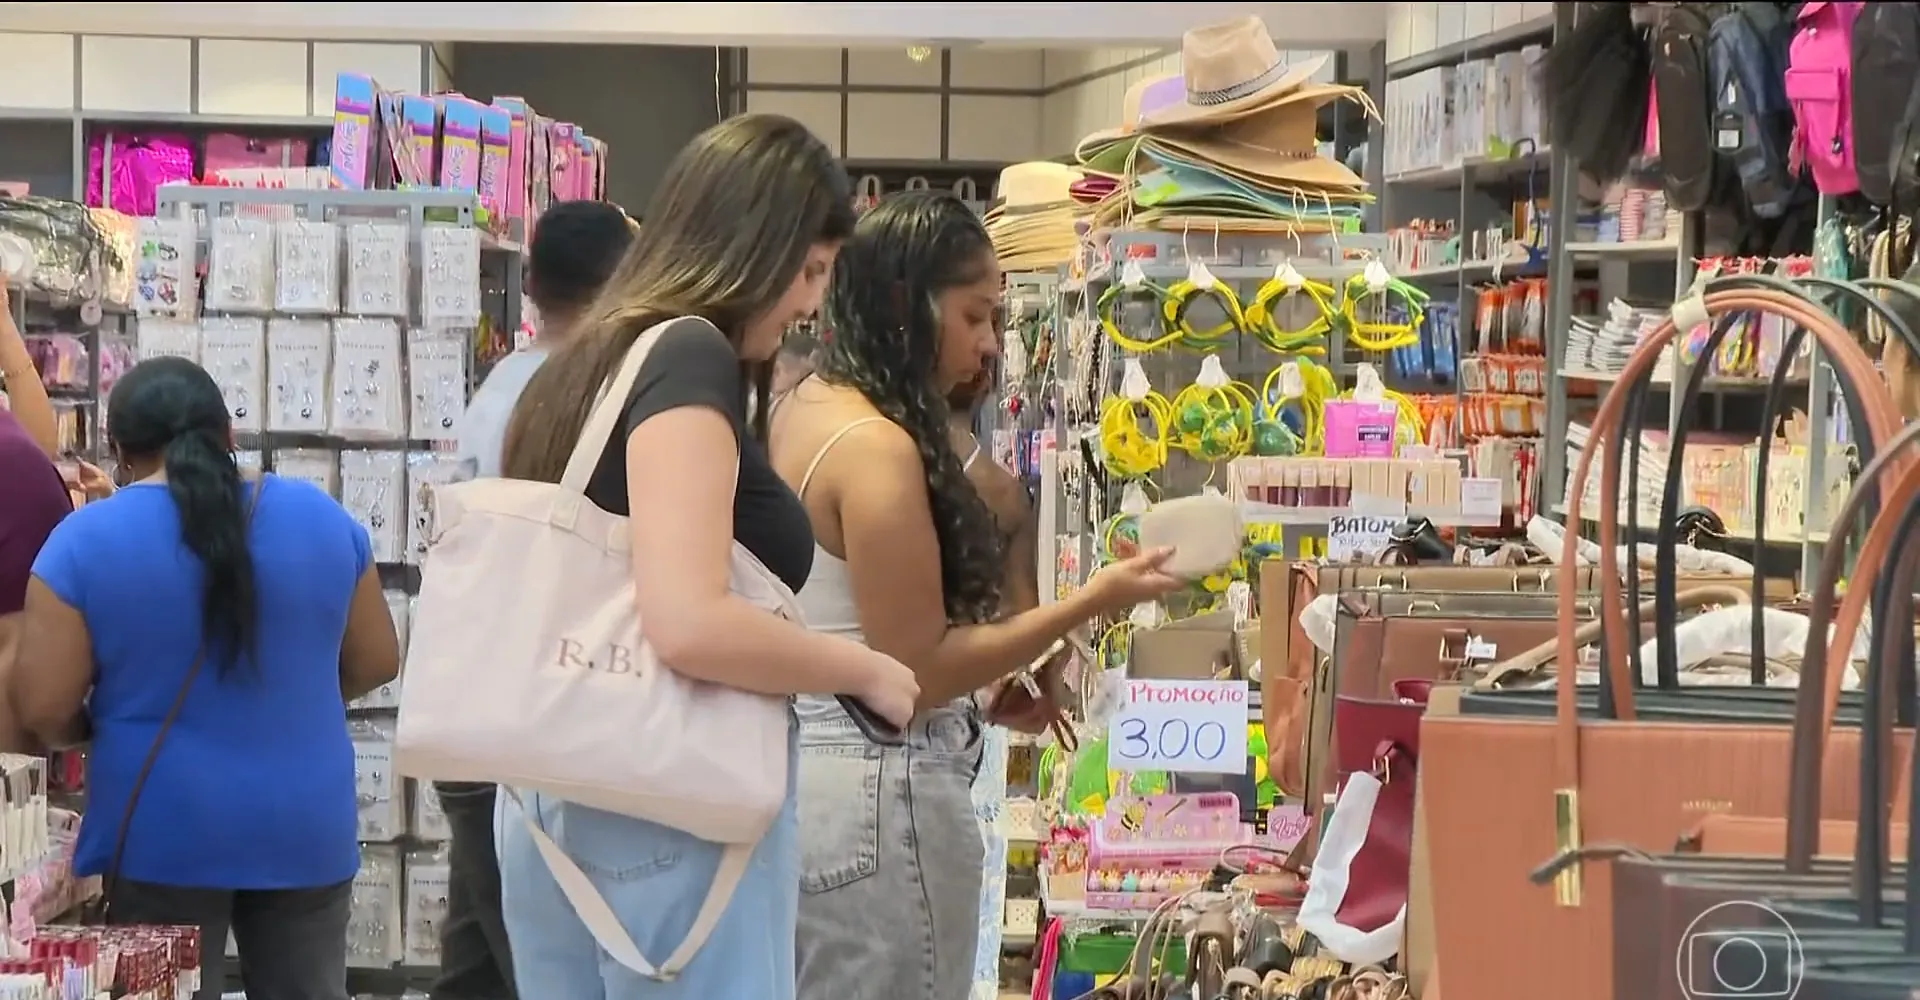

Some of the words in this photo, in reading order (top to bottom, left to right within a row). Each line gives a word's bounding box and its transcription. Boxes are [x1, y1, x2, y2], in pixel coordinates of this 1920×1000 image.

[1331, 516, 1395, 537] BATOM
[557, 638, 594, 668] R.
[606, 642, 642, 678] B.
[1118, 718, 1225, 760] 3,00
